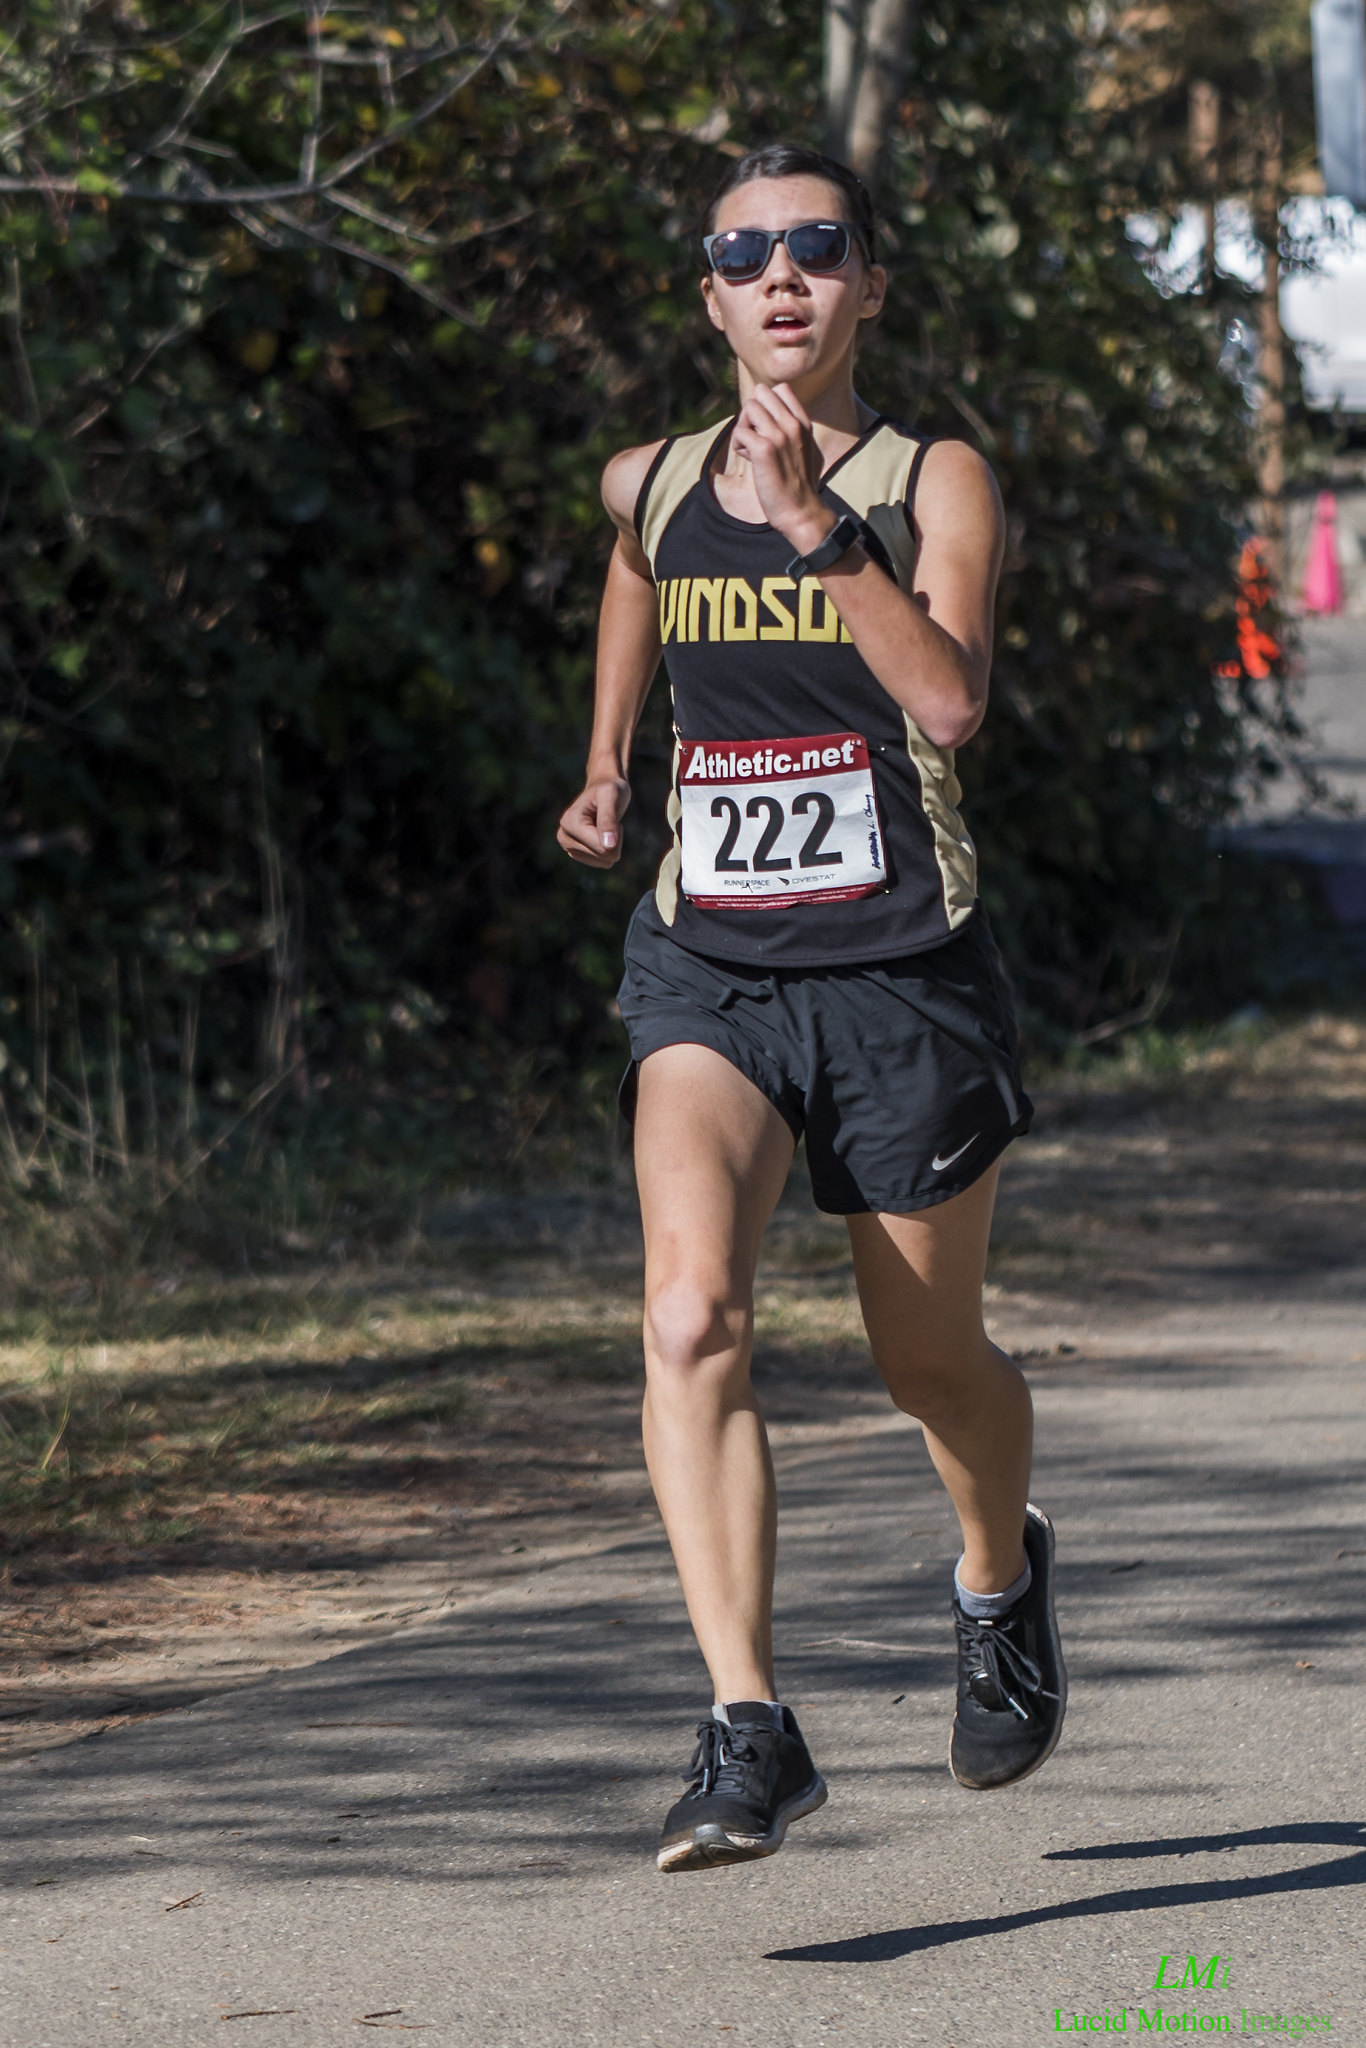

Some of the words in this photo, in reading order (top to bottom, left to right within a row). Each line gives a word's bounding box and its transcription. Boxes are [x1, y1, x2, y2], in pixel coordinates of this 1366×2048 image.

[656, 577, 855, 645] WINDSO
[684, 740, 854, 779] Athletic.net
[710, 791, 843, 872] 222
